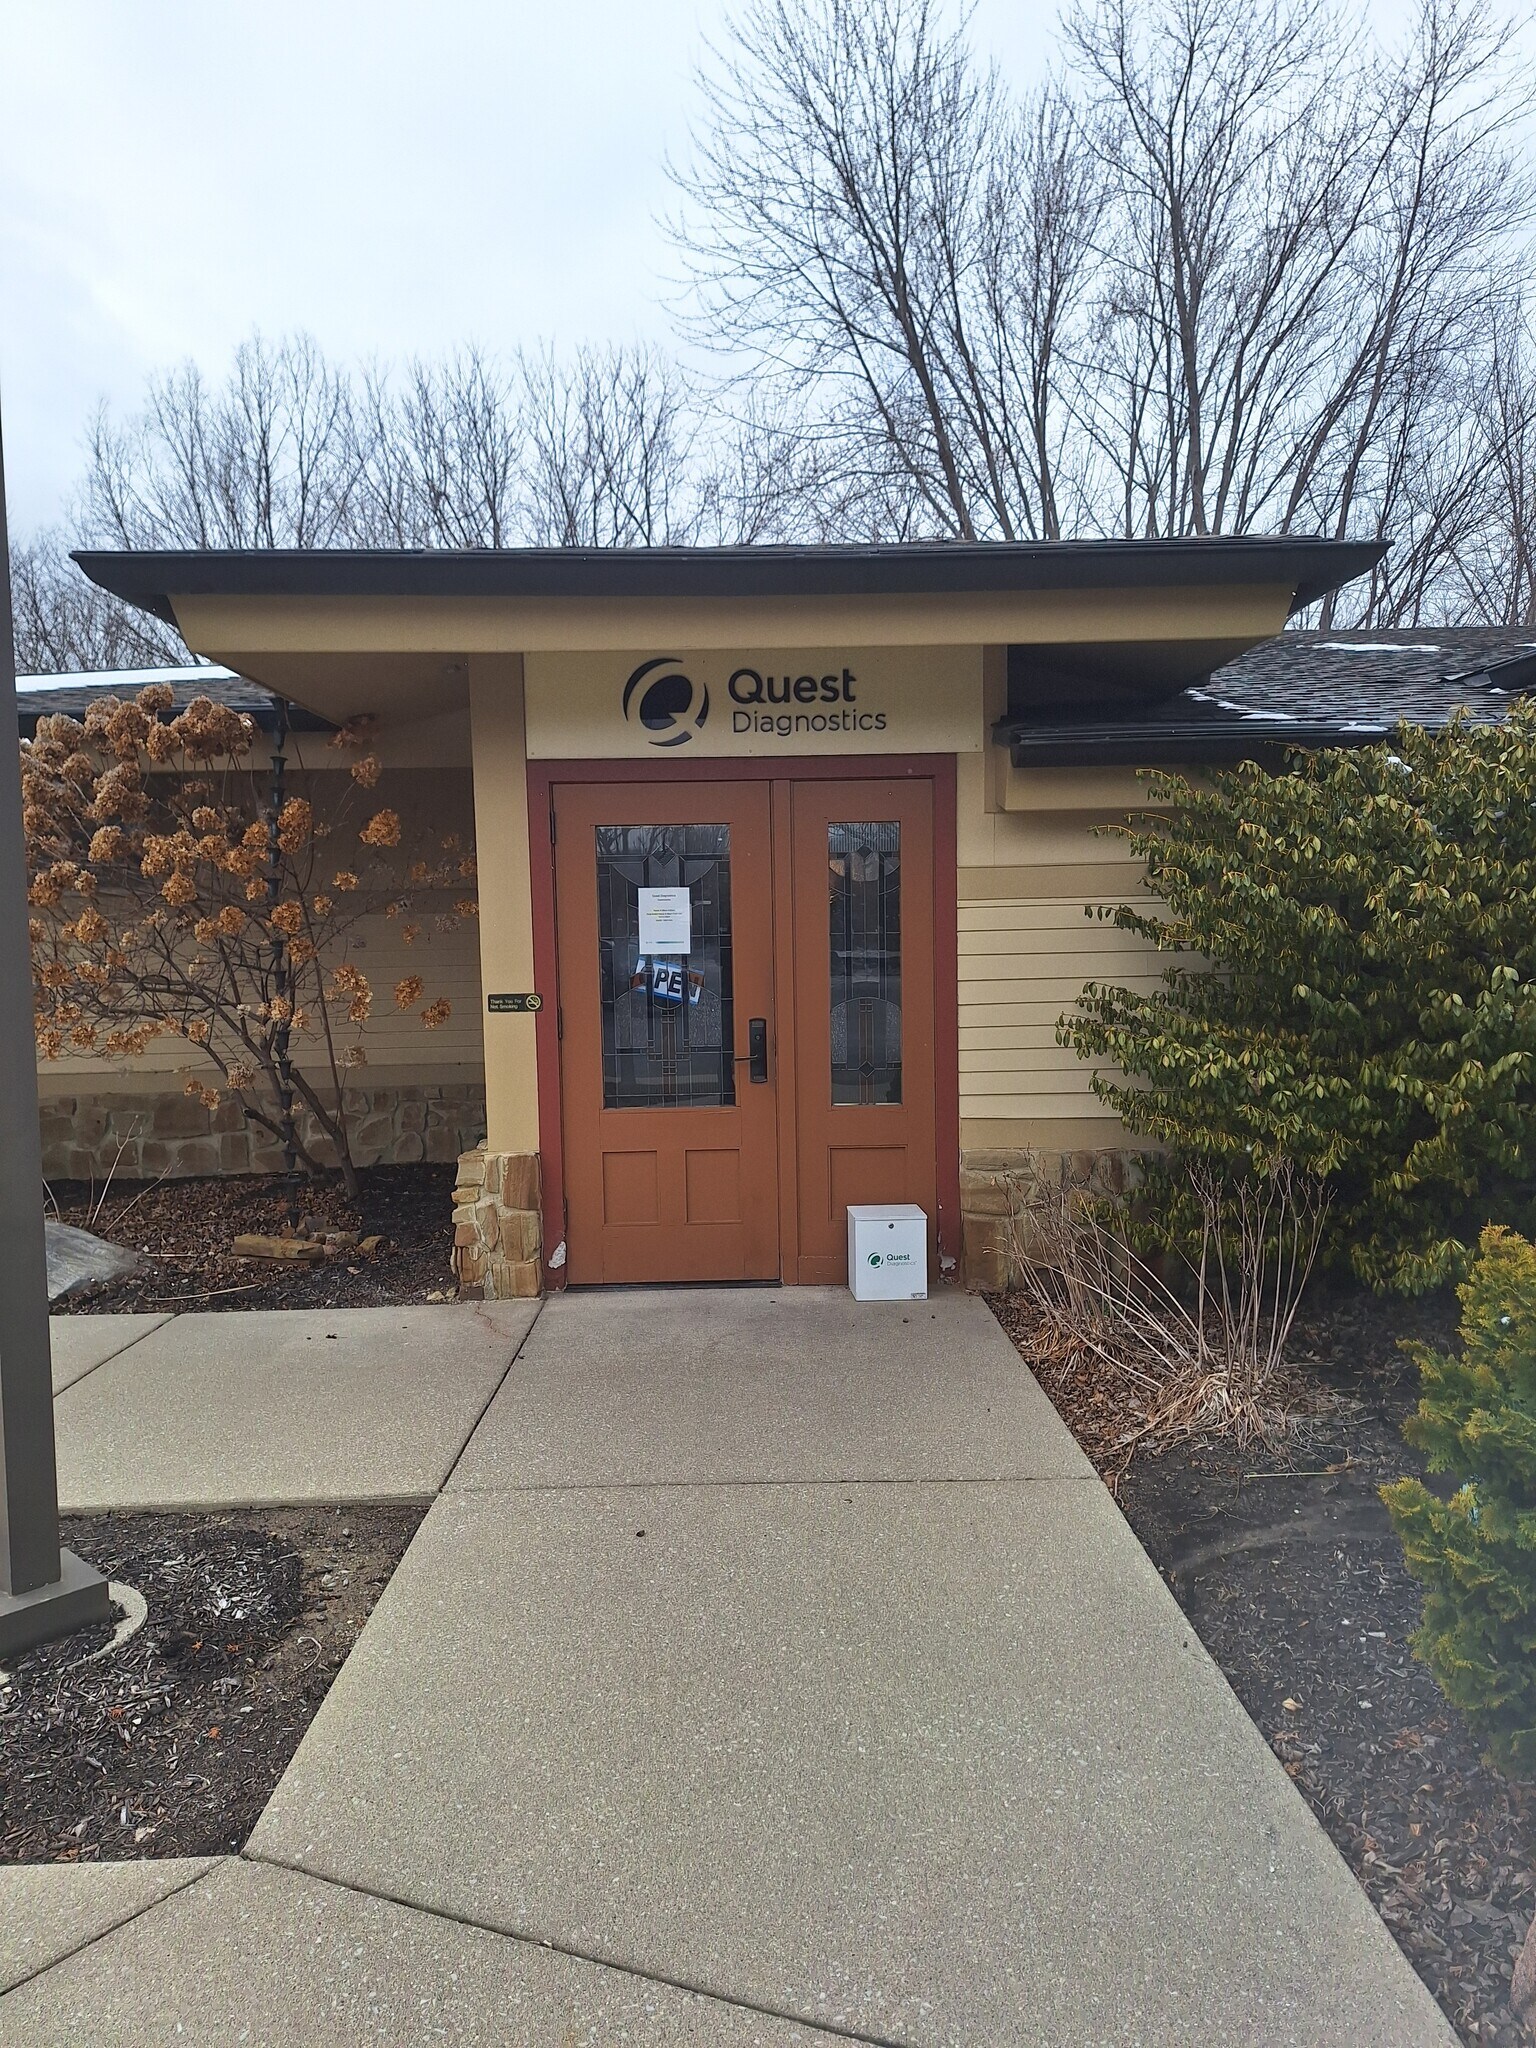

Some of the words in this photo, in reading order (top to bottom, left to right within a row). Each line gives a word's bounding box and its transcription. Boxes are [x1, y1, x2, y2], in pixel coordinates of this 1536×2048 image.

[728, 668, 857, 704] Quest
[732, 709, 887, 737] Diagnostics
[886, 1253, 911, 1261] Quest
